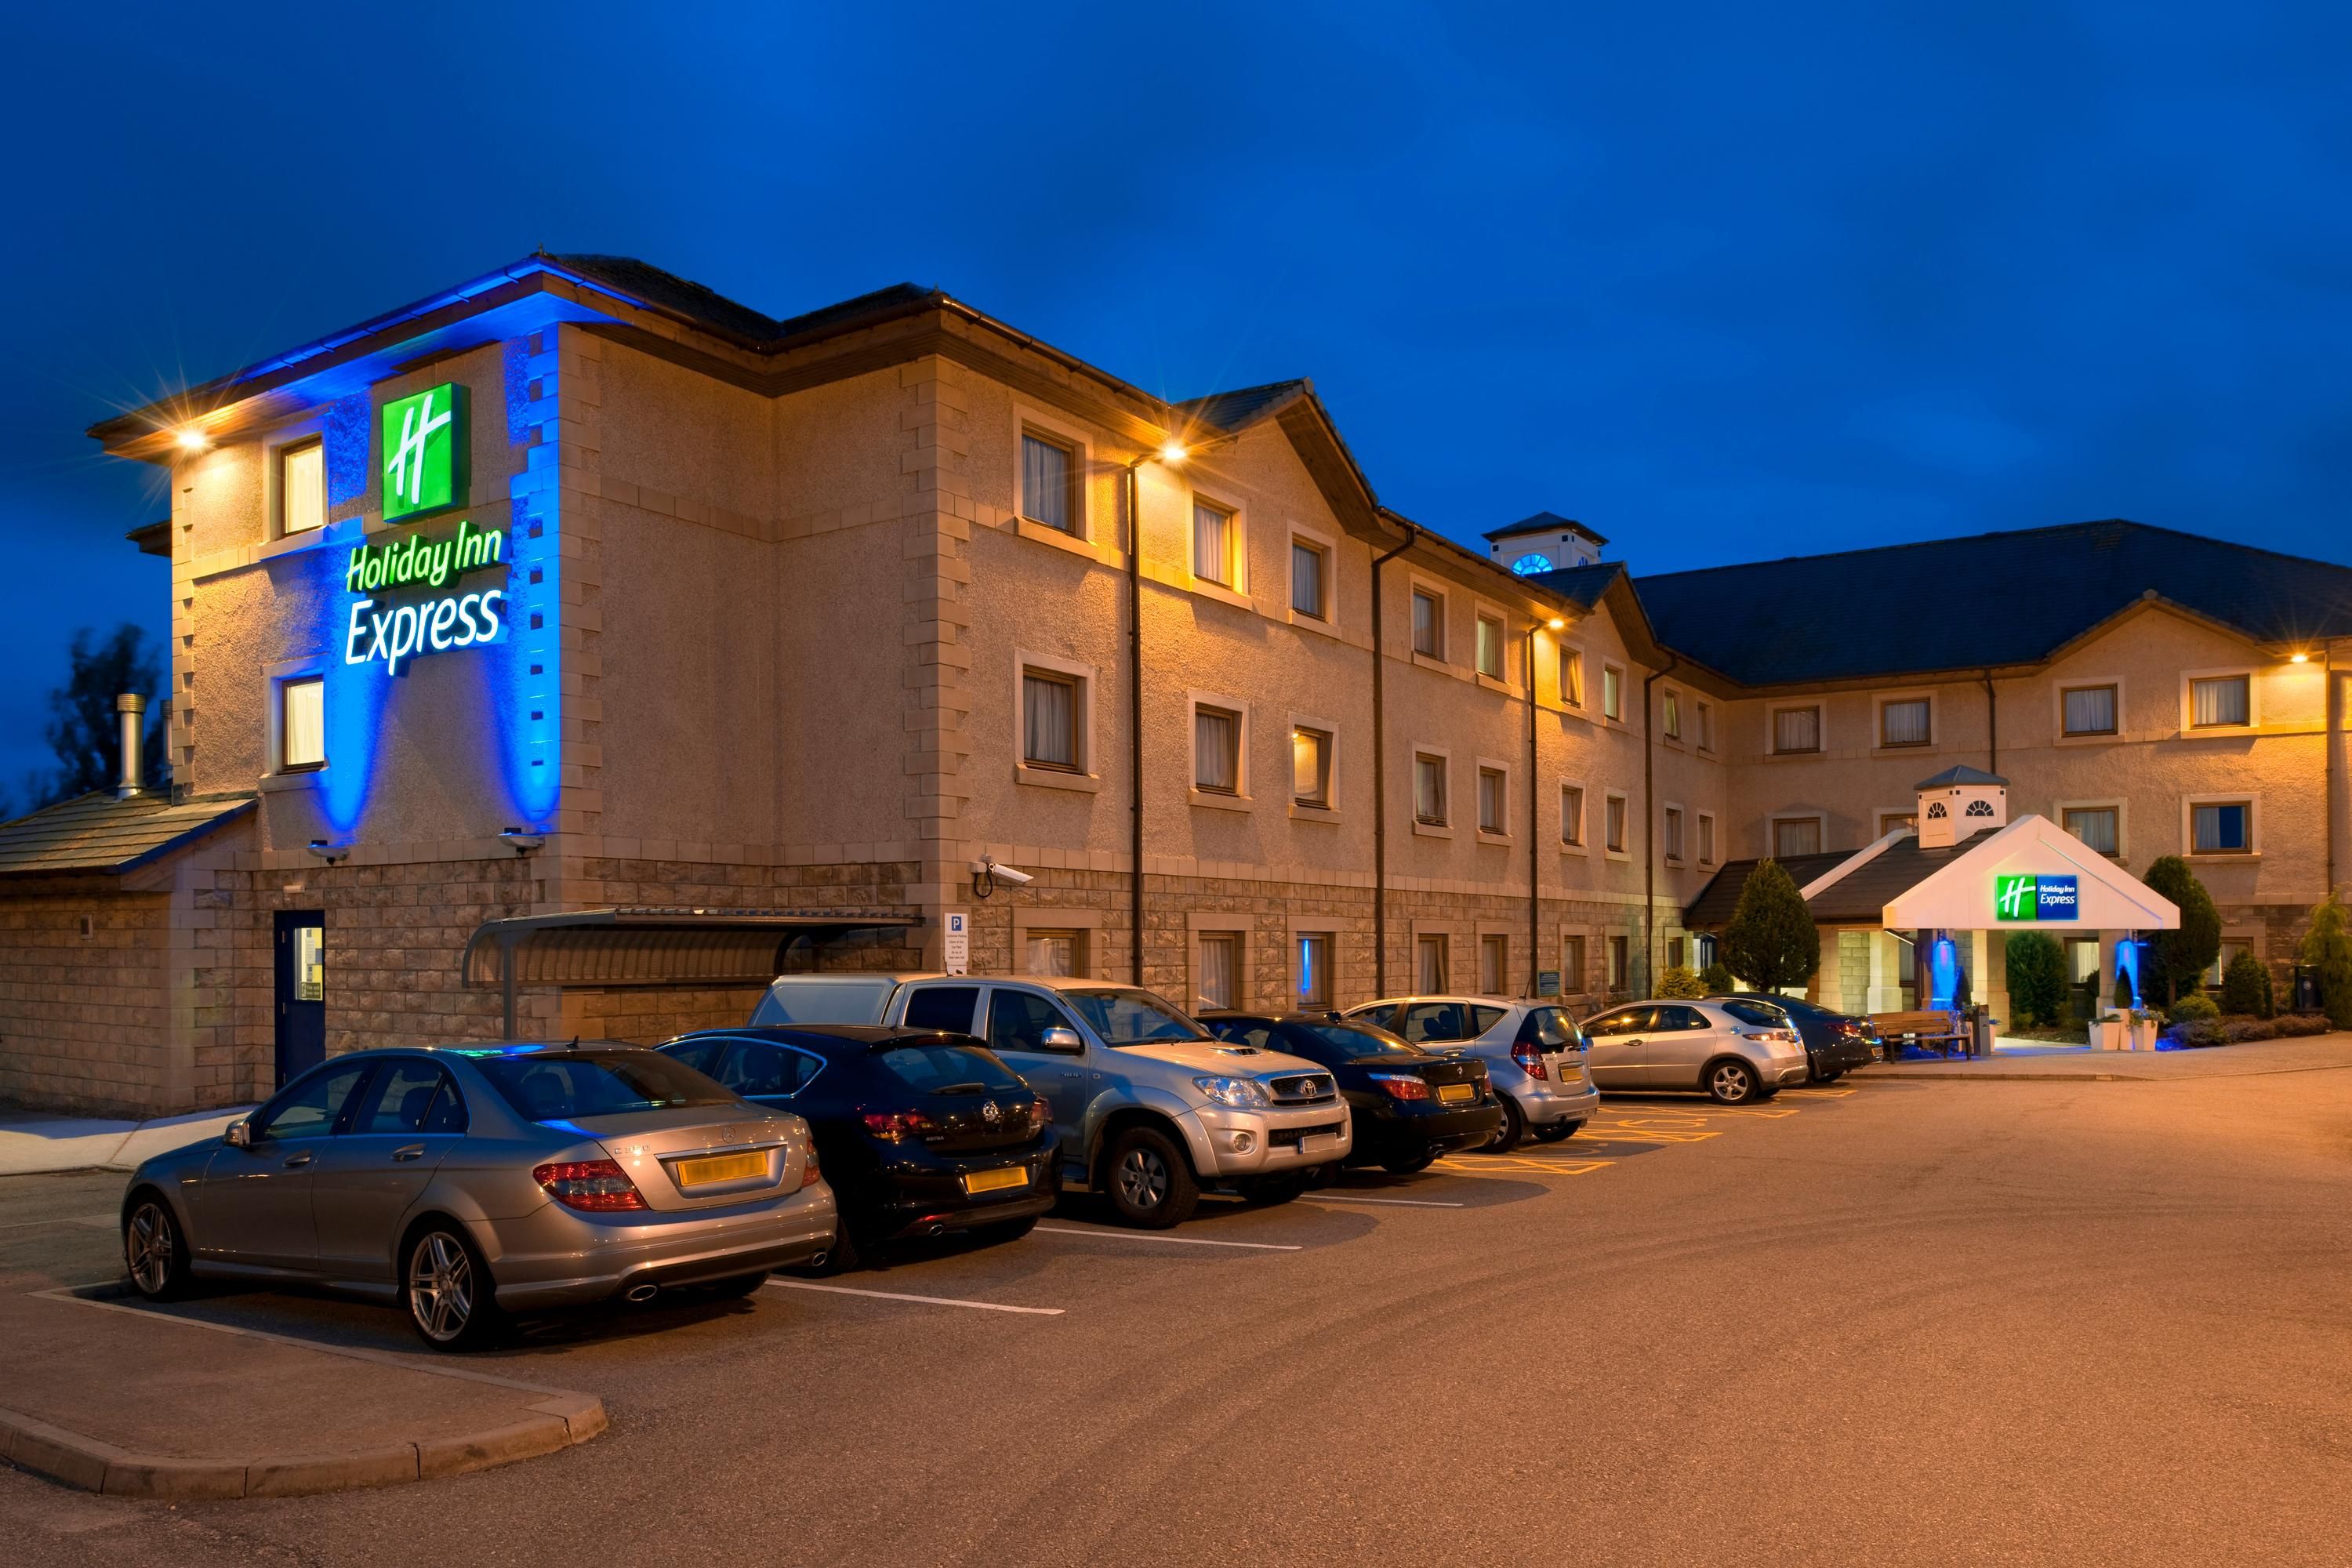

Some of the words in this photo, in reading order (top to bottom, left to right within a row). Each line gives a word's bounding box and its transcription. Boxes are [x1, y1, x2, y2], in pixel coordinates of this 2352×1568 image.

[346, 534, 452, 593] Holiday
[454, 520, 503, 570] Inn
[345, 589, 503, 676] Express
[2040, 884, 2065, 895] Holiday
[2064, 884, 2075, 893] Inn
[2040, 893, 2076, 906] Express
[953, 917, 960, 929] P
